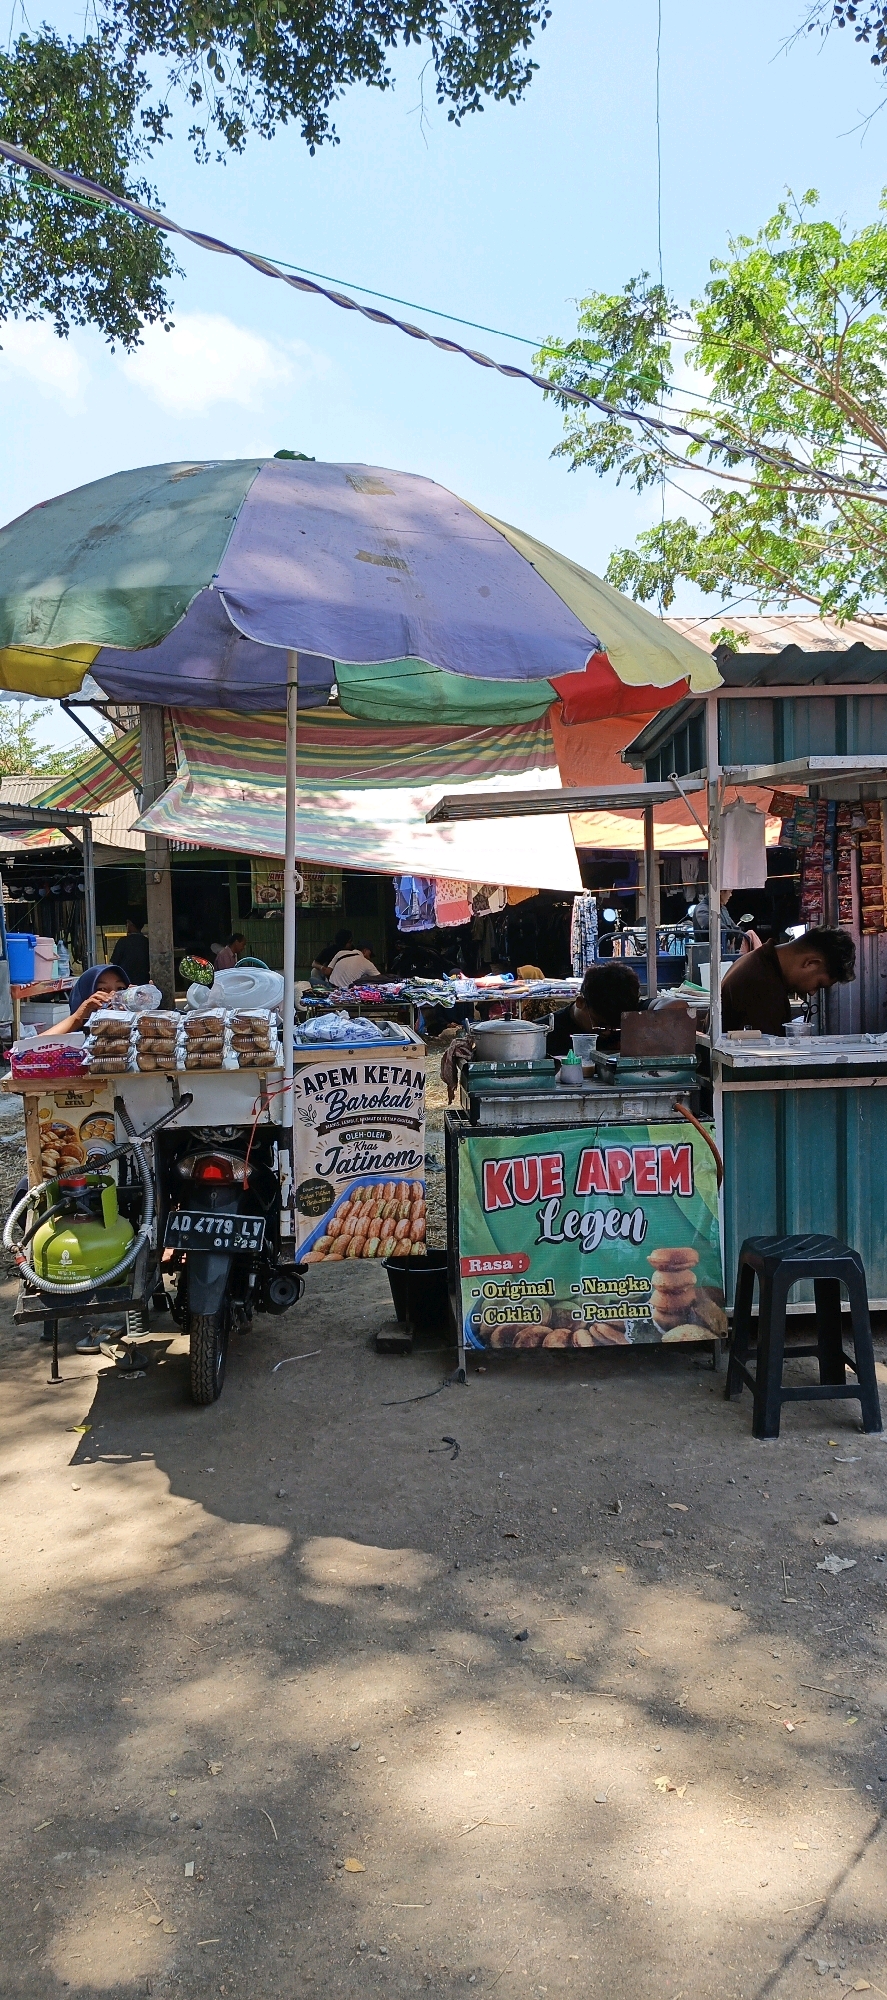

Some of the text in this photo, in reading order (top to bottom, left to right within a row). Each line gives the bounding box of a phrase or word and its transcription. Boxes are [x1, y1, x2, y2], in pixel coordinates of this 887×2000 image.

[303, 1065, 425, 1096] APEM KETAN
[345, 1131, 386, 1141] OLEH-OLEH
[353, 1141, 378, 1151] Khas
[315, 1146, 423, 1176] Jatinom
[484, 1145, 693, 1212] KUE APEM
[170, 1215, 192, 1232] AD
[194, 1216, 234, 1235] 4779
[536, 1197, 648, 1251] Legen
[468, 1258, 514, 1272] Rasa
[483, 1281, 554, 1300] Original
[583, 1276, 651, 1299] Nangka
[484, 1306, 541, 1325] Coklat
[585, 1303, 652, 1321] Pandan
